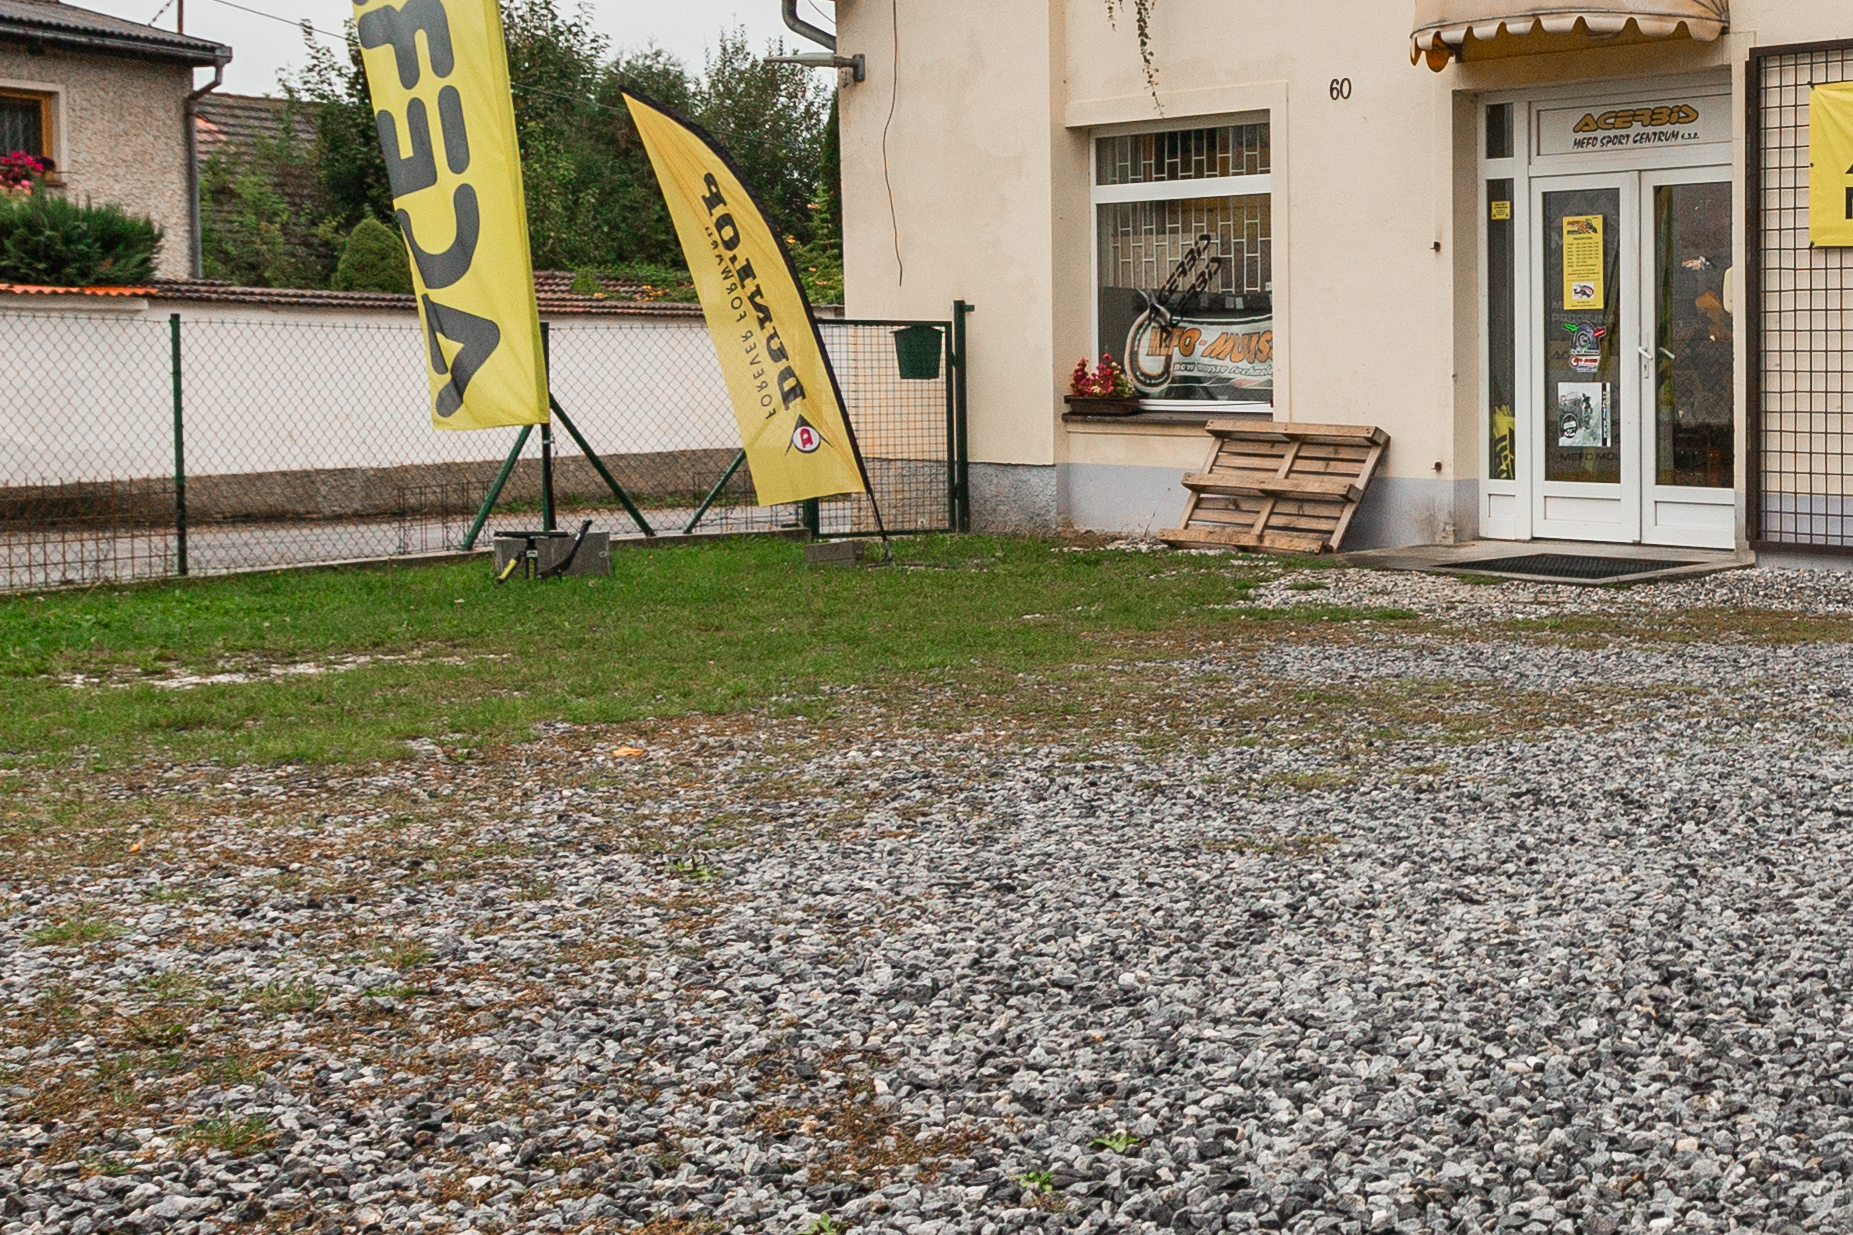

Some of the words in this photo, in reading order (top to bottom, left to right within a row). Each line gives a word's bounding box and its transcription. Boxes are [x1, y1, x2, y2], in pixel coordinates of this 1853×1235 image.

[1329, 77, 1352, 100] 60
[1572, 136, 1599, 150] MEFO
[1600, 134, 1631, 148] SPORT
[1632, 130, 1680, 144] CENTRUM
